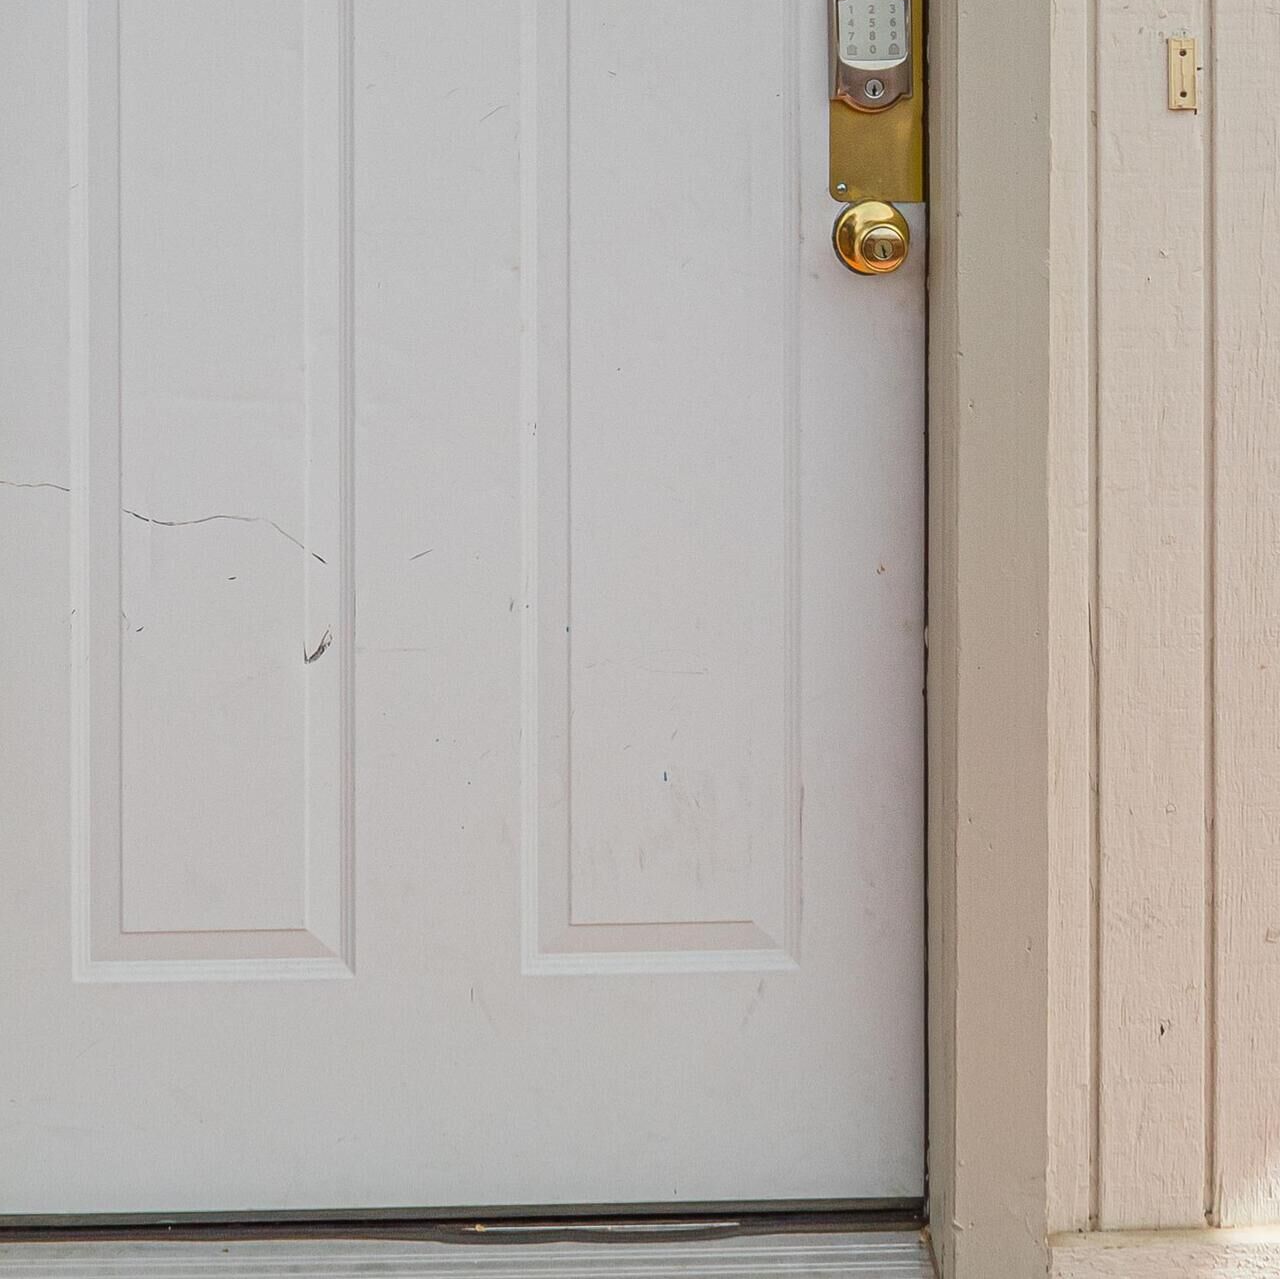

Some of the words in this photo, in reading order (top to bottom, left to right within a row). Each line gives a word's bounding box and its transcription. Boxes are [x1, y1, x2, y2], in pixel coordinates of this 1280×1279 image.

[868, 5, 875, 14] 2
[889, 4, 896, 14] 3
[848, 19, 854, 27] 4
[869, 18, 875, 27] 5
[889, 18, 896, 27] 6
[848, 32, 855, 40] 7
[869, 31, 876, 40] 8
[890, 31, 897, 40] 9
[869, 45, 876, 54] 0
